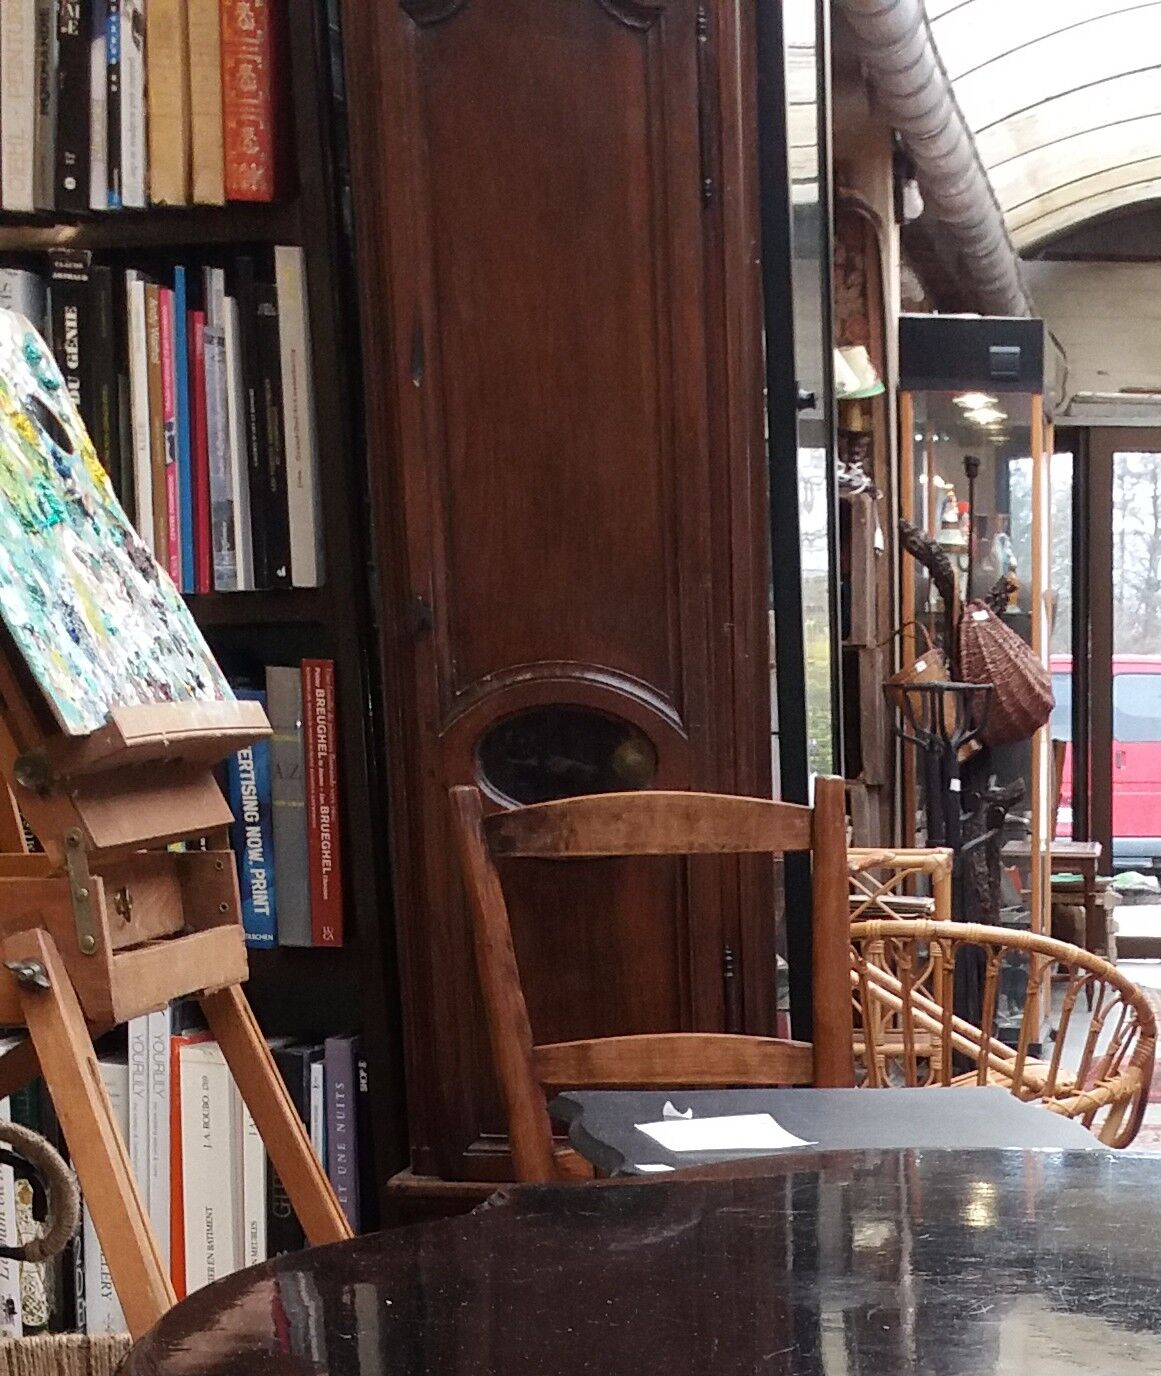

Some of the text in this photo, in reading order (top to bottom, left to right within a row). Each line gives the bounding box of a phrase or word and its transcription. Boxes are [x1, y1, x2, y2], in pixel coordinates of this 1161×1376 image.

[64, 305, 79, 369] GÉNIE
[315, 688, 328, 760] BREUGHEL
[238, 744, 270, 916] ERTISING NOW. PRINT
[319, 805, 332, 875] BRUEGHEL
[335, 1082, 348, 1203] ET UNE NUITS
[205, 1206, 214, 1251] BATIMENT
[207, 1253, 215, 1266] EN
[100, 1252, 112, 1301] LLERY
